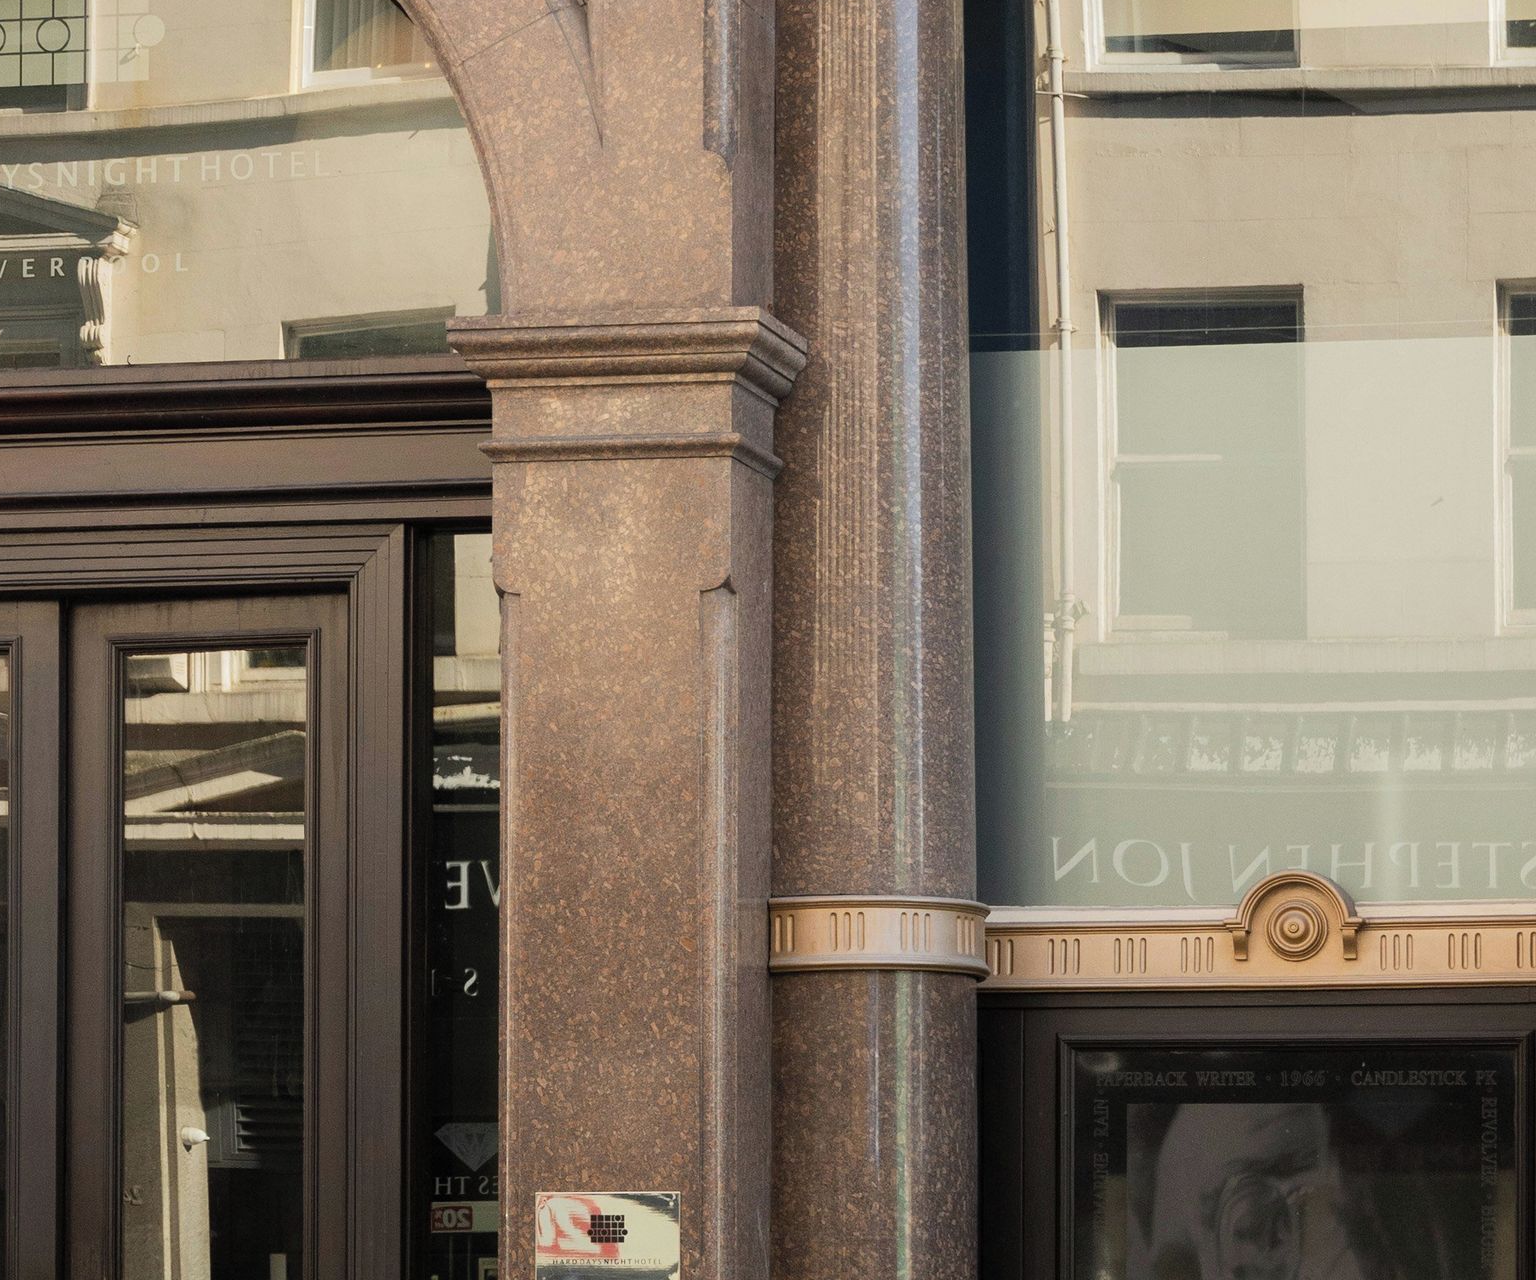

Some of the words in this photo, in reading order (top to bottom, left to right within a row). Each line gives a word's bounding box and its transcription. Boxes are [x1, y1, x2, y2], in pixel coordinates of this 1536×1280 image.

[201, 151, 331, 181] HOTEL
[1096, 1069, 1187, 1087] PAPERBACK
[1196, 1069, 1256, 1087] WRITER
[1279, 1068, 1326, 1087] 1966
[1350, 1068, 1466, 1086] CANDLESTICK
[1475, 1069, 1497, 1086] PK
[1091, 1098, 1108, 1138] RAIN
[1481, 1096, 1499, 1188] REVOLVER
